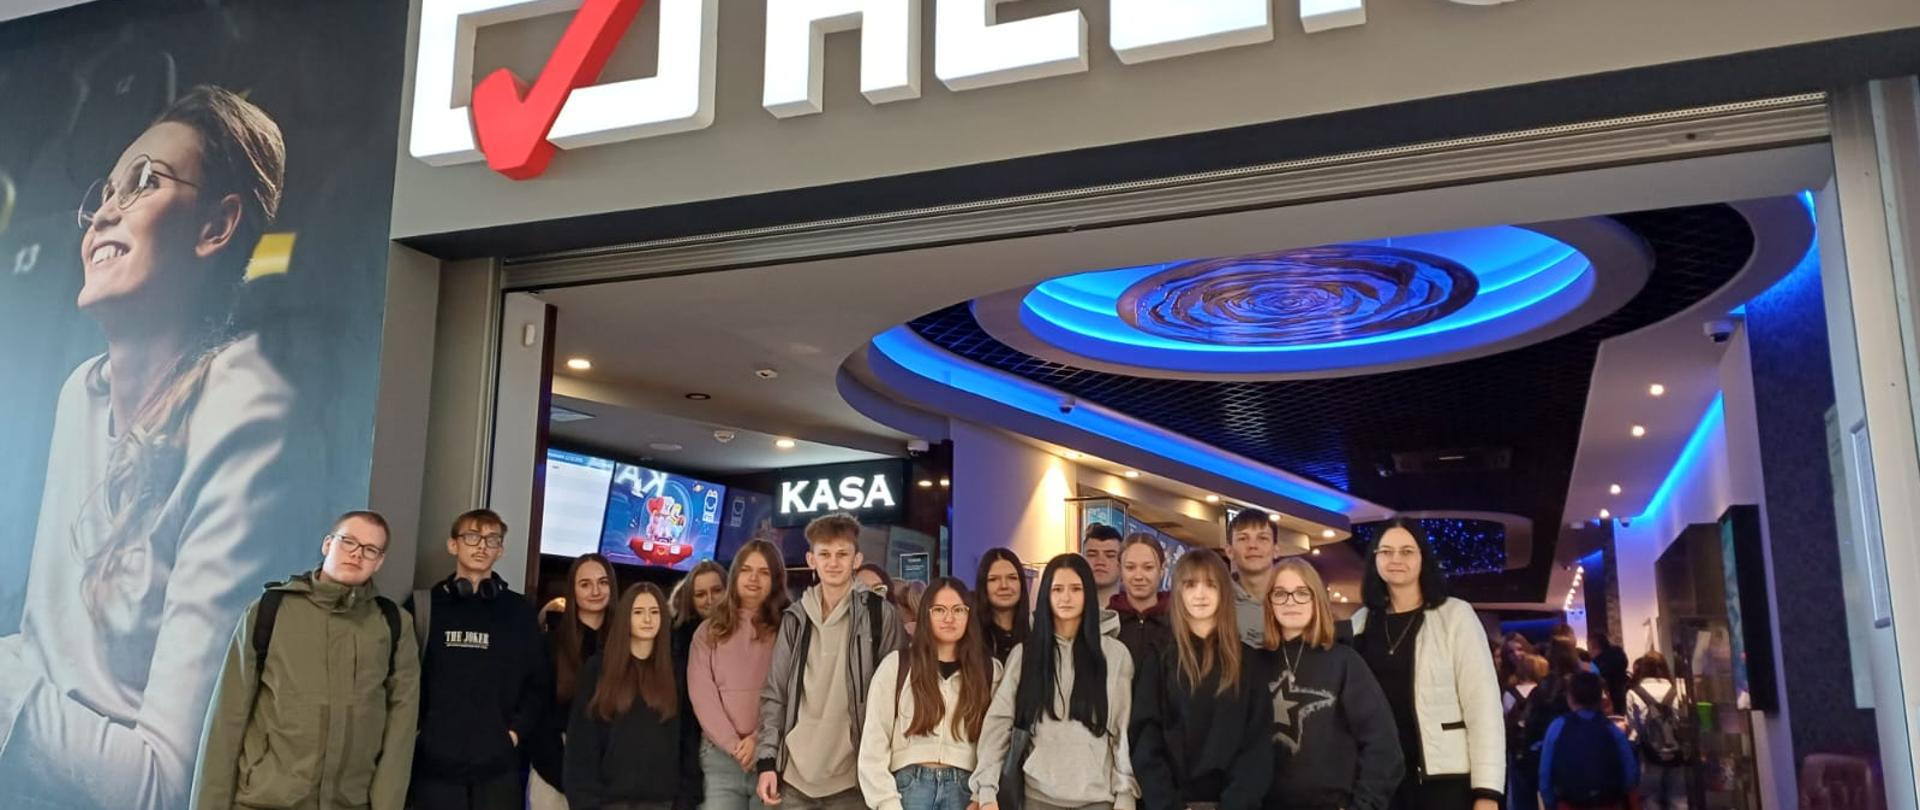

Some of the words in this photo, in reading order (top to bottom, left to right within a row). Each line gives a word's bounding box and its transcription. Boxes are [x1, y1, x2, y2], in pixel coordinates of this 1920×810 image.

[780, 474, 896, 514] KASA
[445, 630, 463, 642] THE
[463, 631, 490, 645] JOKER
